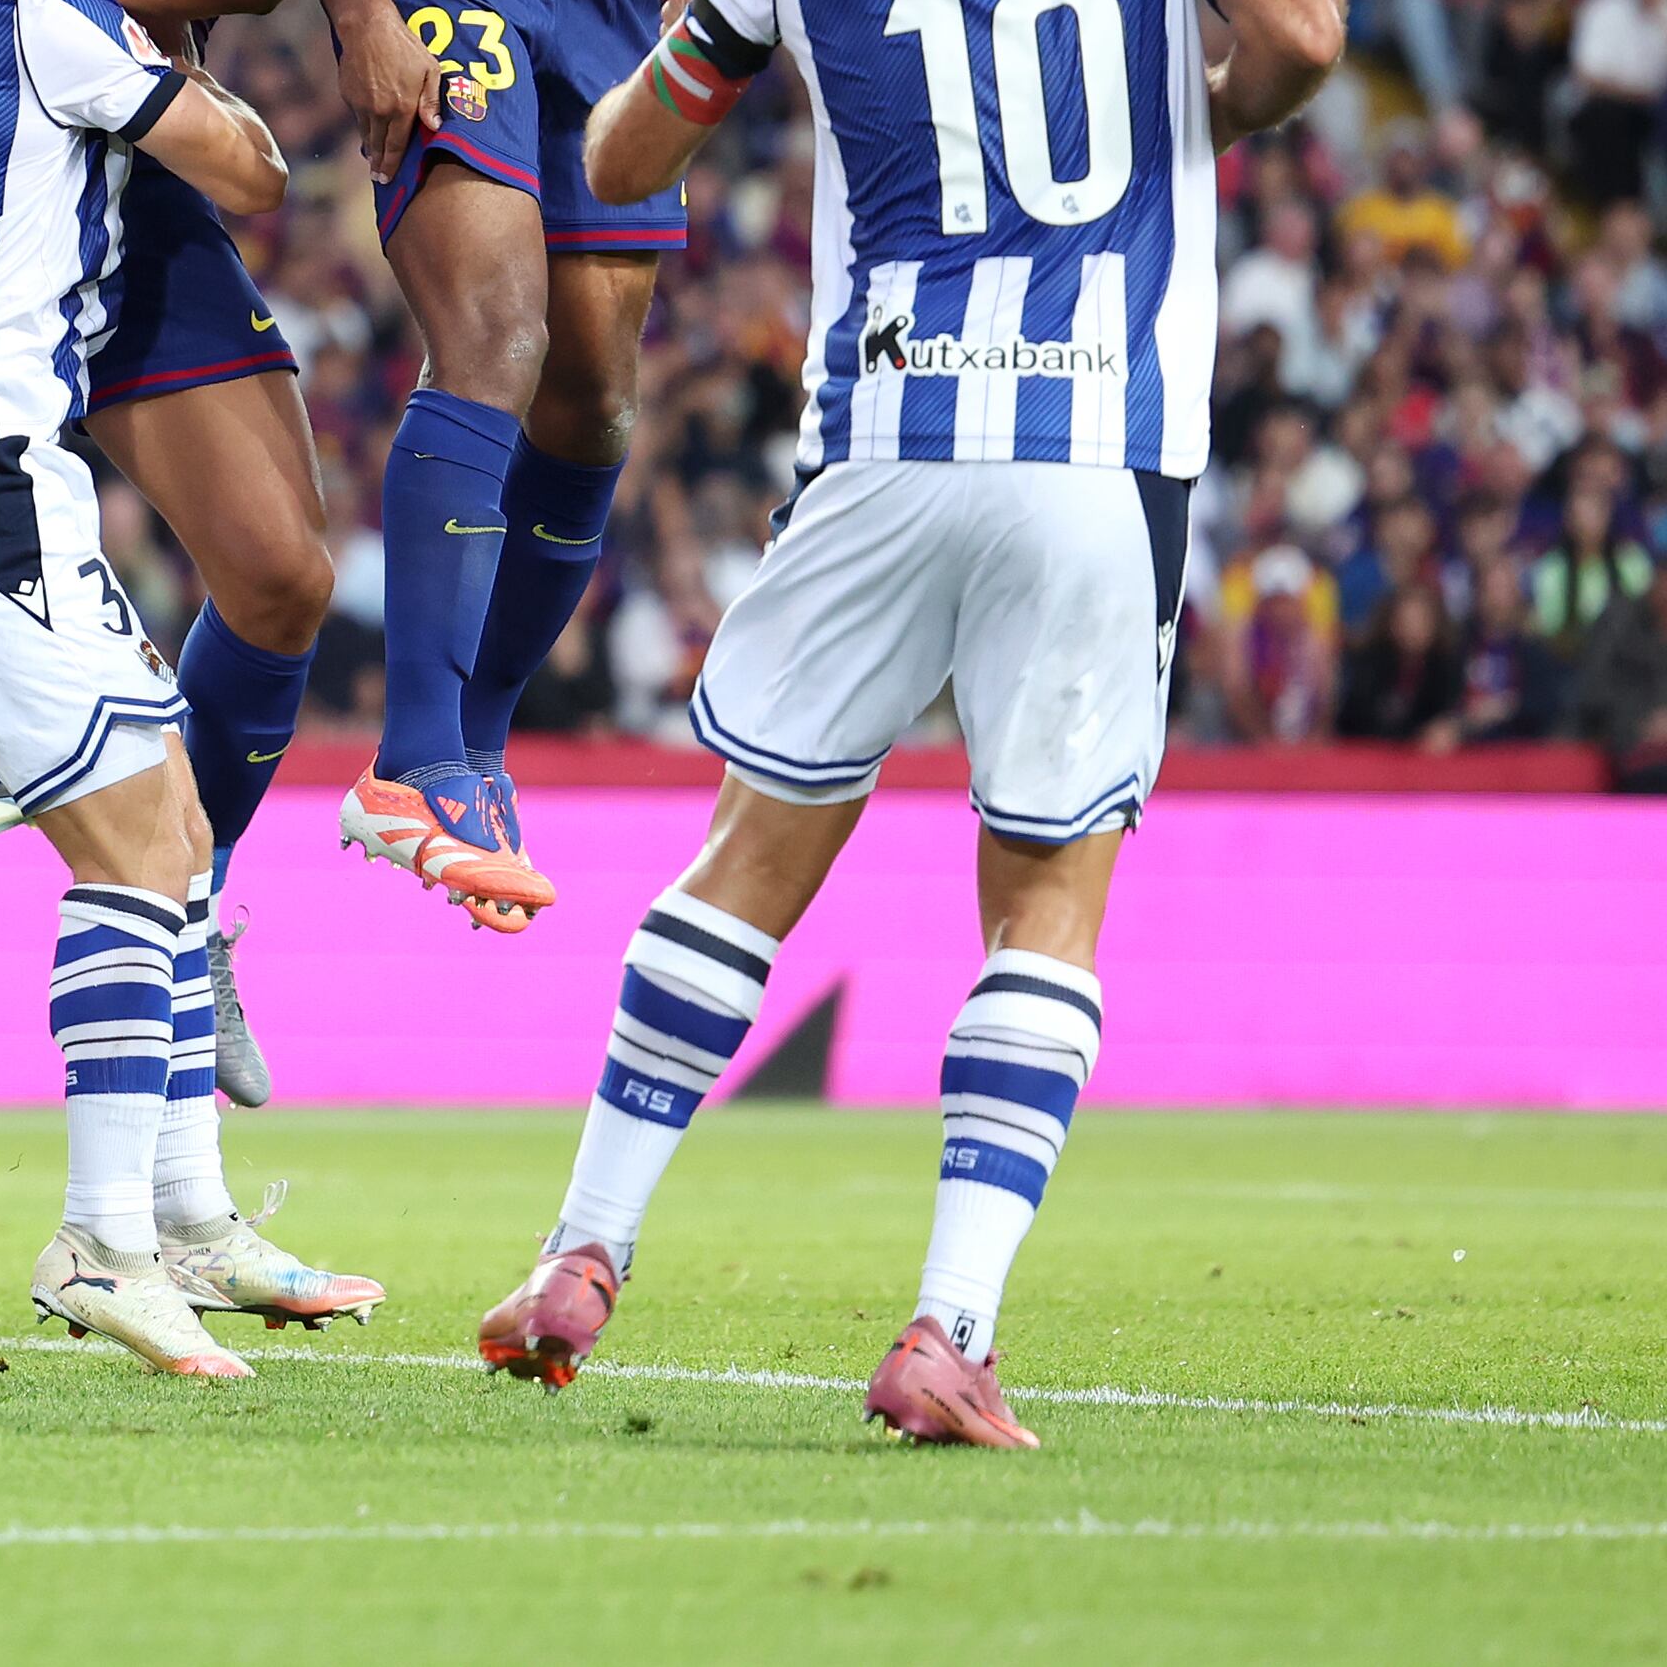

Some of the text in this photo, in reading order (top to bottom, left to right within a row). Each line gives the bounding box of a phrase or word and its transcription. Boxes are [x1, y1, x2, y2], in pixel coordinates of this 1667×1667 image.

[407, 6, 516, 90] 23
[866, 304, 1119, 376] Kutxabank
[77, 557, 133, 636] 3
[622, 1078, 675, 1114] RS
